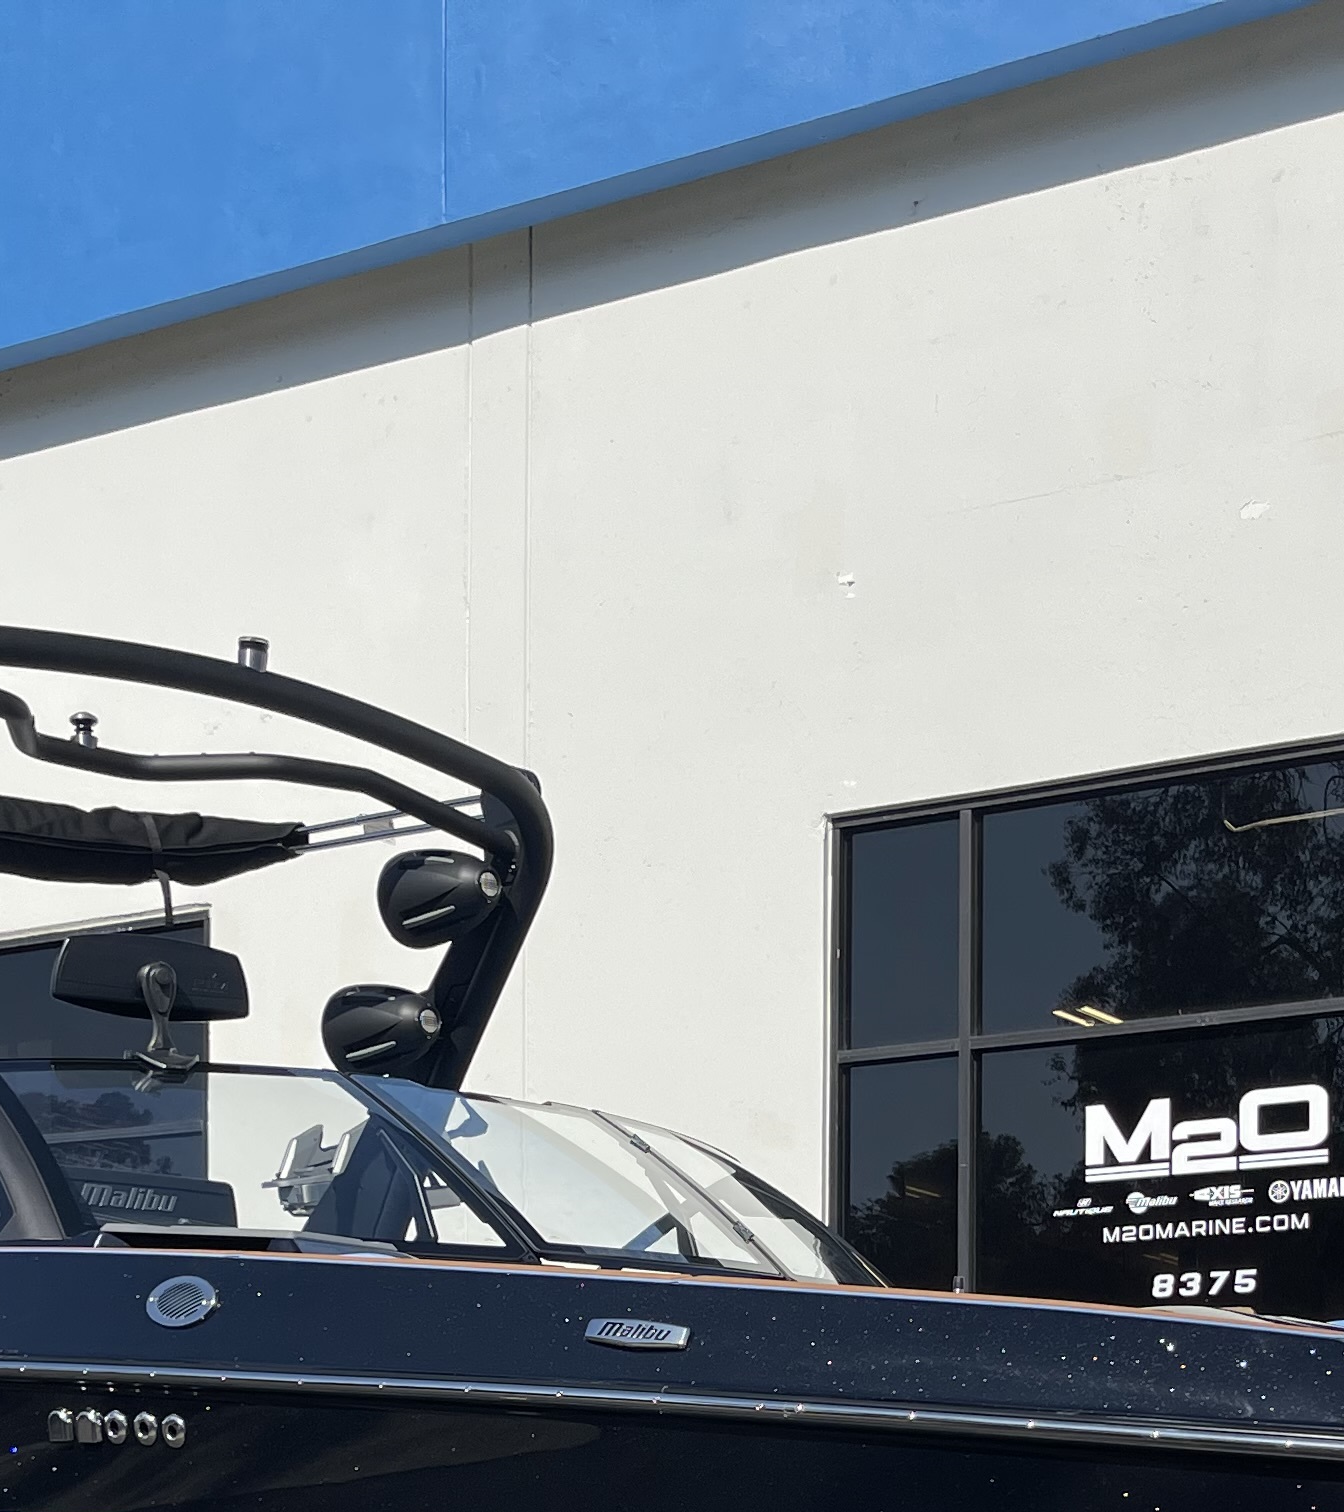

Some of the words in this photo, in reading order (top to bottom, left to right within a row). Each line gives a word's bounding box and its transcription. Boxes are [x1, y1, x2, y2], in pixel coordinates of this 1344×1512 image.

[81, 1183, 178, 1212] Malibu
[1152, 1269, 1257, 1298] 8375
[597, 1321, 671, 1341] Malibu
